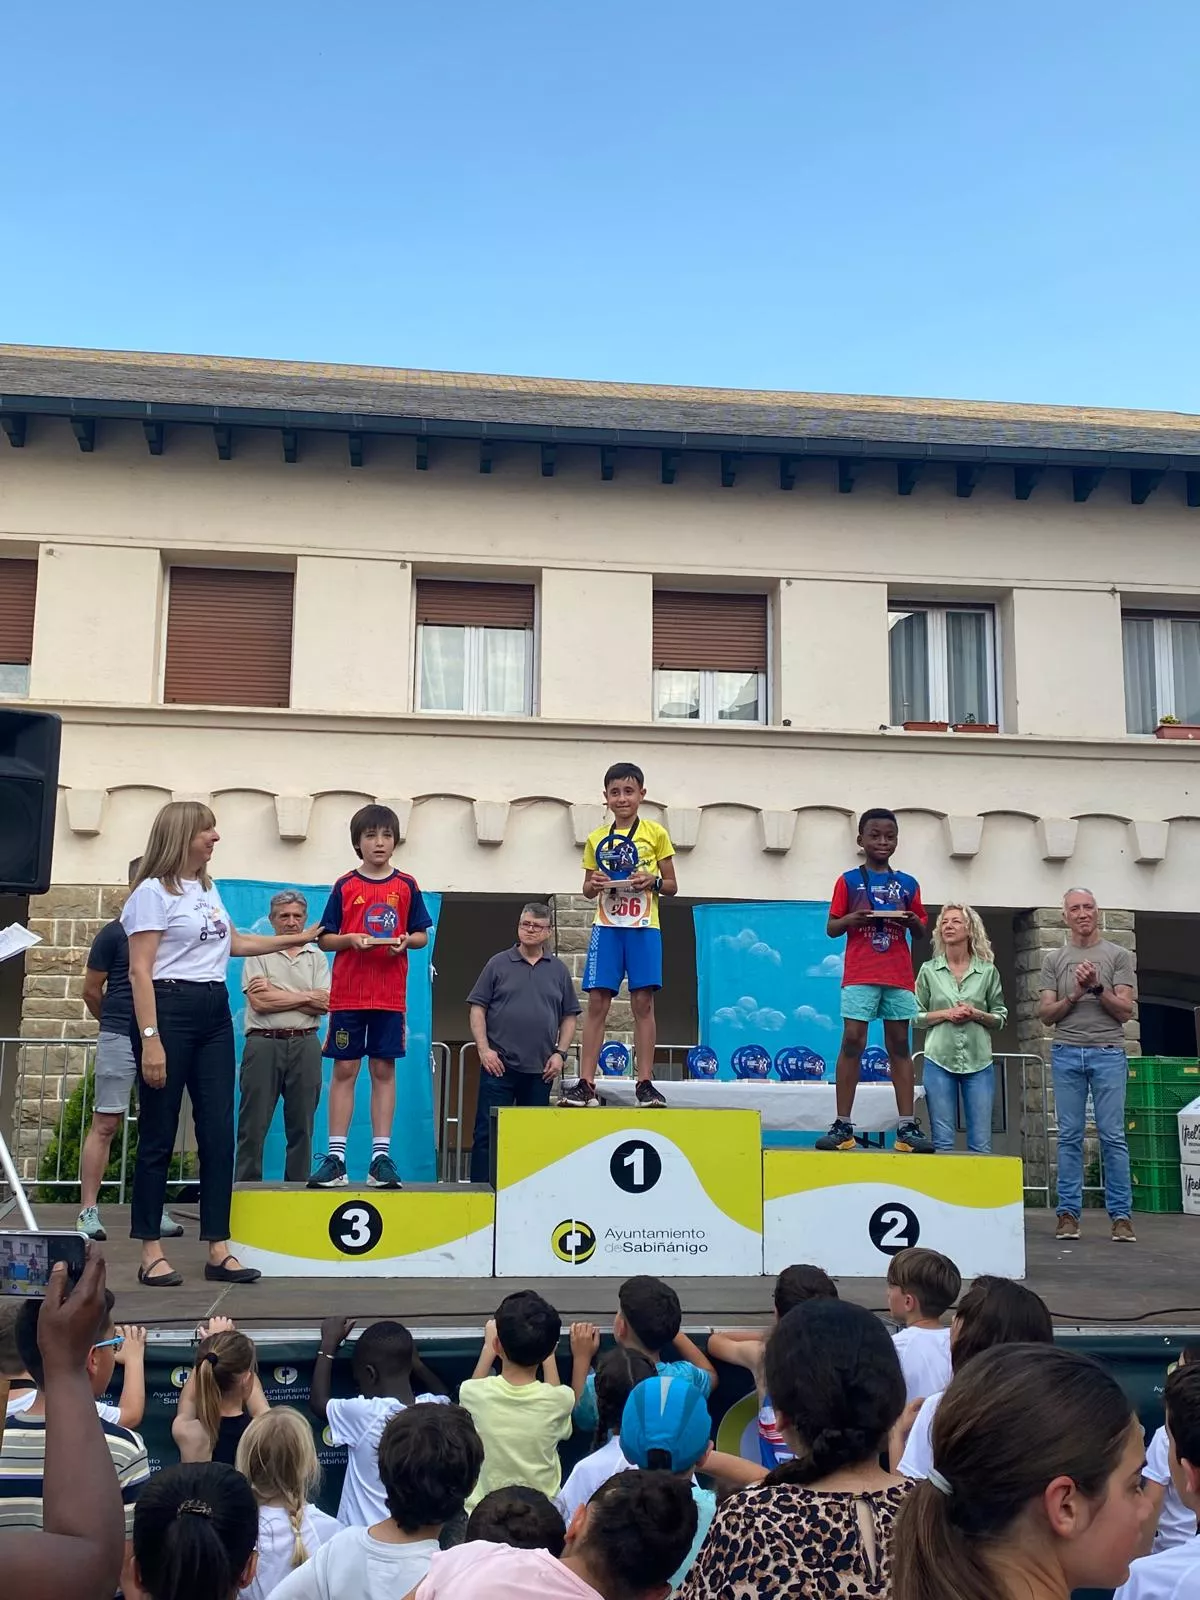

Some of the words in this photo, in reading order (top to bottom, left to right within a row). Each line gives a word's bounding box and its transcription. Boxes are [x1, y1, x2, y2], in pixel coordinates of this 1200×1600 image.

[623, 1148, 645, 1185] 1
[340, 1208, 371, 1247] 3
[604, 1227, 706, 1241] Ayuntamiento
[880, 1210, 909, 1247] 2
